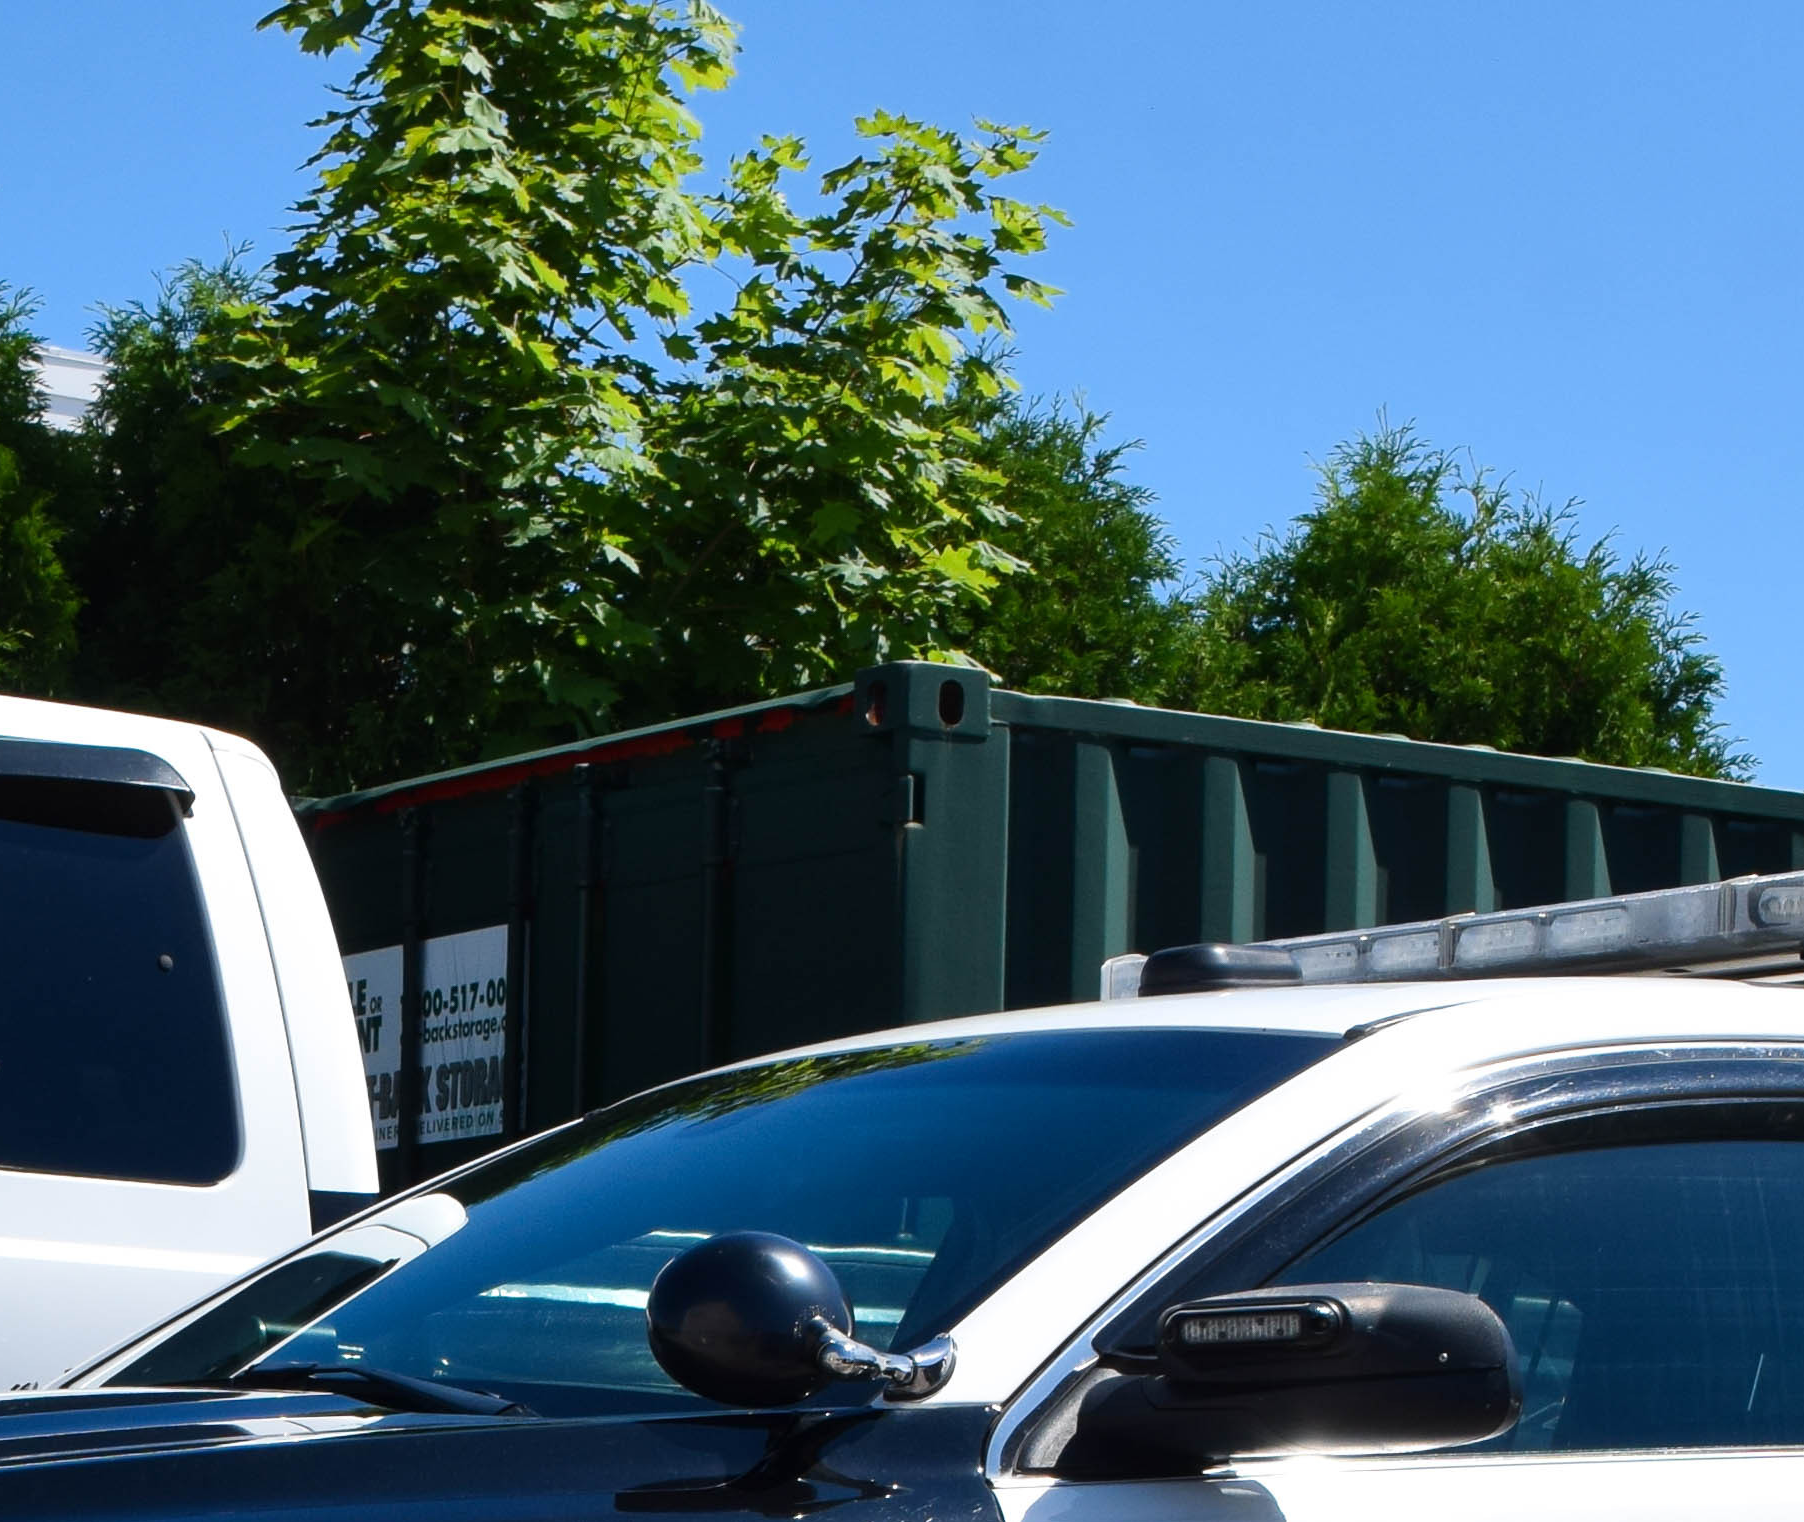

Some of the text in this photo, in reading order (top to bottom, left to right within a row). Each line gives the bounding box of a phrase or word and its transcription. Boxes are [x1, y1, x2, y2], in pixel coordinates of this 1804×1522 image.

[370, 996, 382, 1014] OR
[436, 1055, 506, 1112] STORA
[419, 1114, 474, 1136] ELIVERED
[478, 1110, 494, 1127] ON
